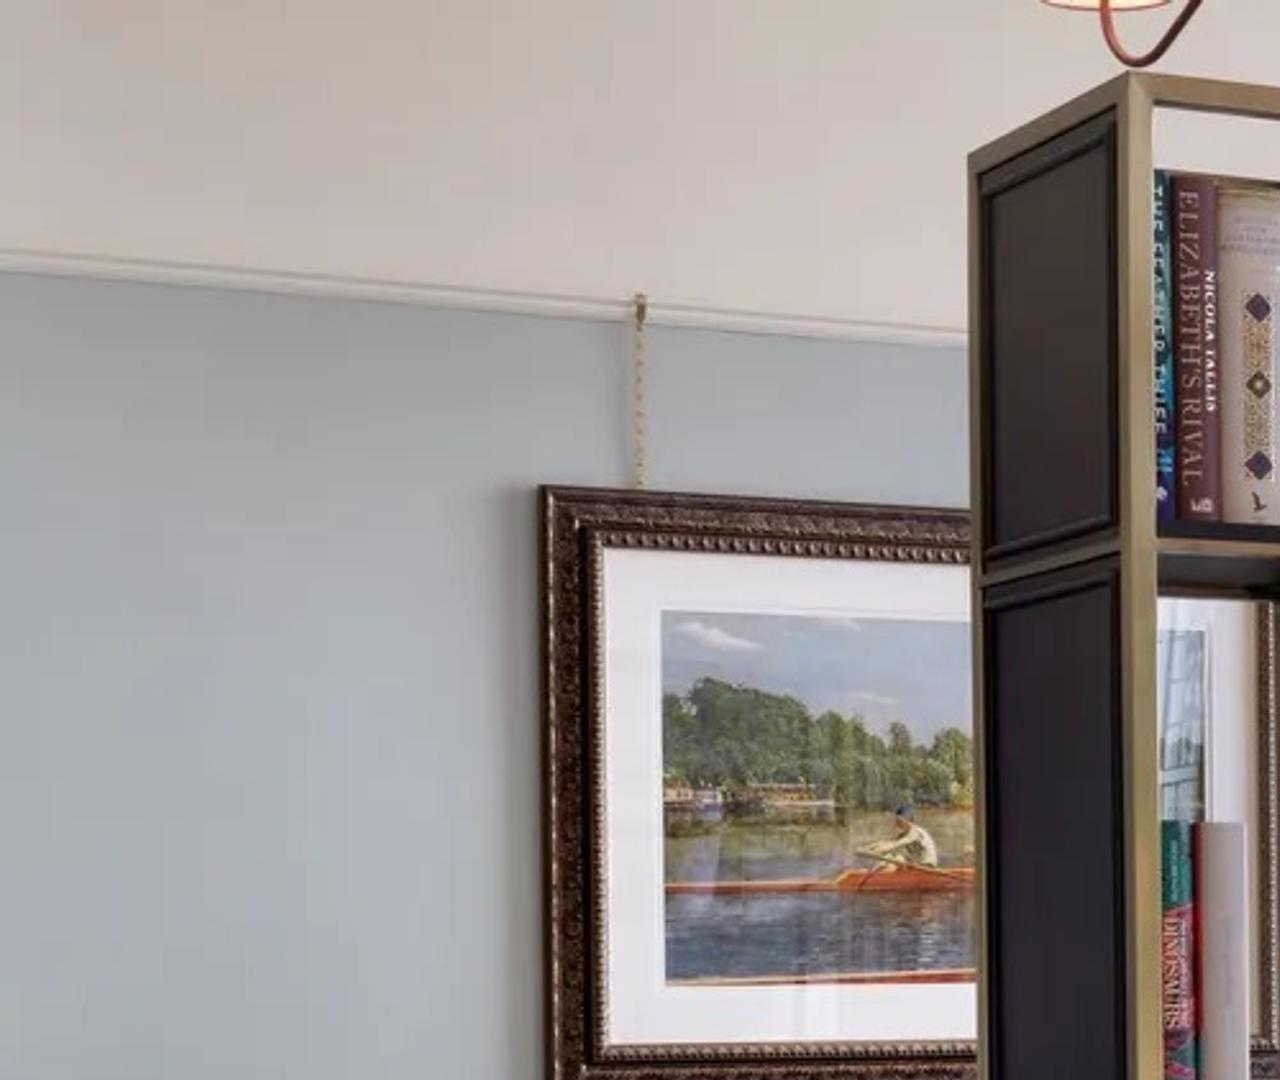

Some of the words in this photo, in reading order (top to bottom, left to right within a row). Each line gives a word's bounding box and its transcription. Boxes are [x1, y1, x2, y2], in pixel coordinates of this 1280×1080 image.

[1179, 190, 1202, 389] ELIZABETH'S
[1205, 269, 1217, 343] NICOLA
[1205, 349, 1217, 413] TALLIS
[1182, 398, 1203, 486] RIVAL
[1164, 917, 1183, 1031] DINOSAURS
